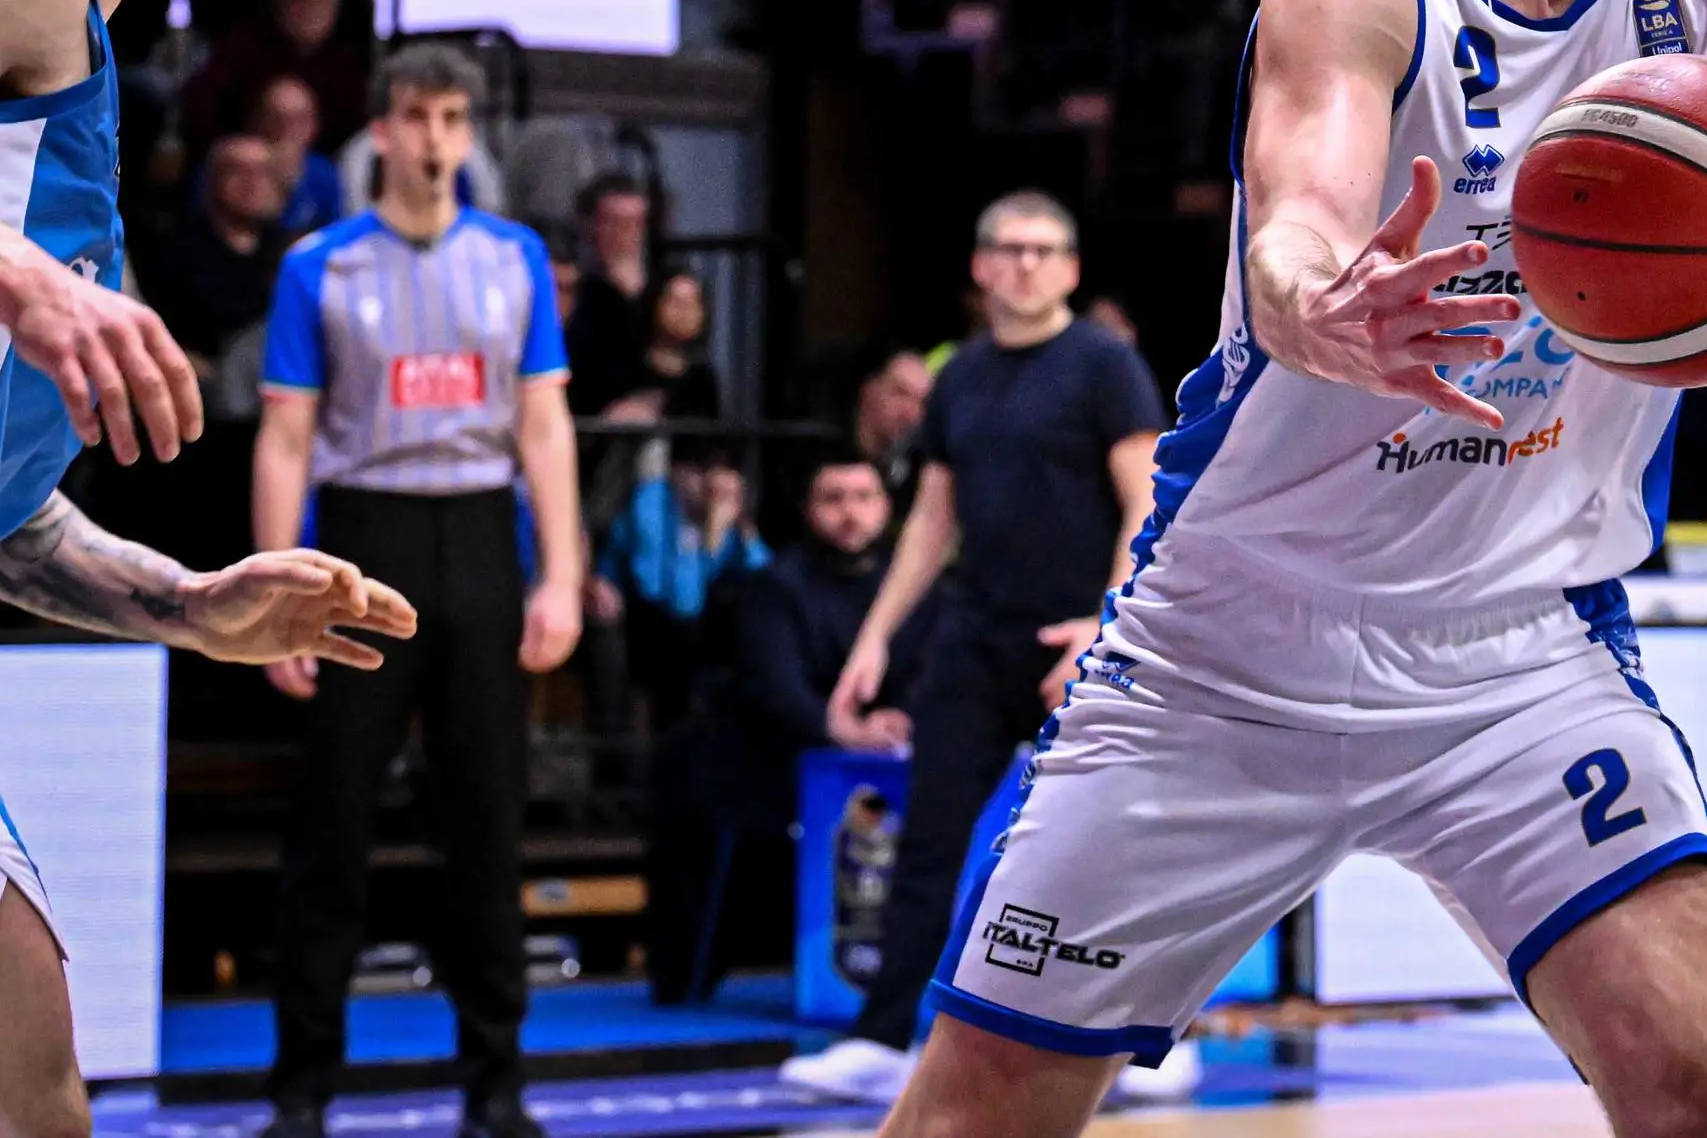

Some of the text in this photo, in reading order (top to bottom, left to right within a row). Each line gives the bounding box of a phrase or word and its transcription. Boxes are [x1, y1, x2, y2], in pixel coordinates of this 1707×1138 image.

[1641, 12, 1678, 32] LBA
[1652, 42, 1683, 56] Unipol
[1453, 25, 1501, 129] 2
[1562, 748, 1647, 848] 2
